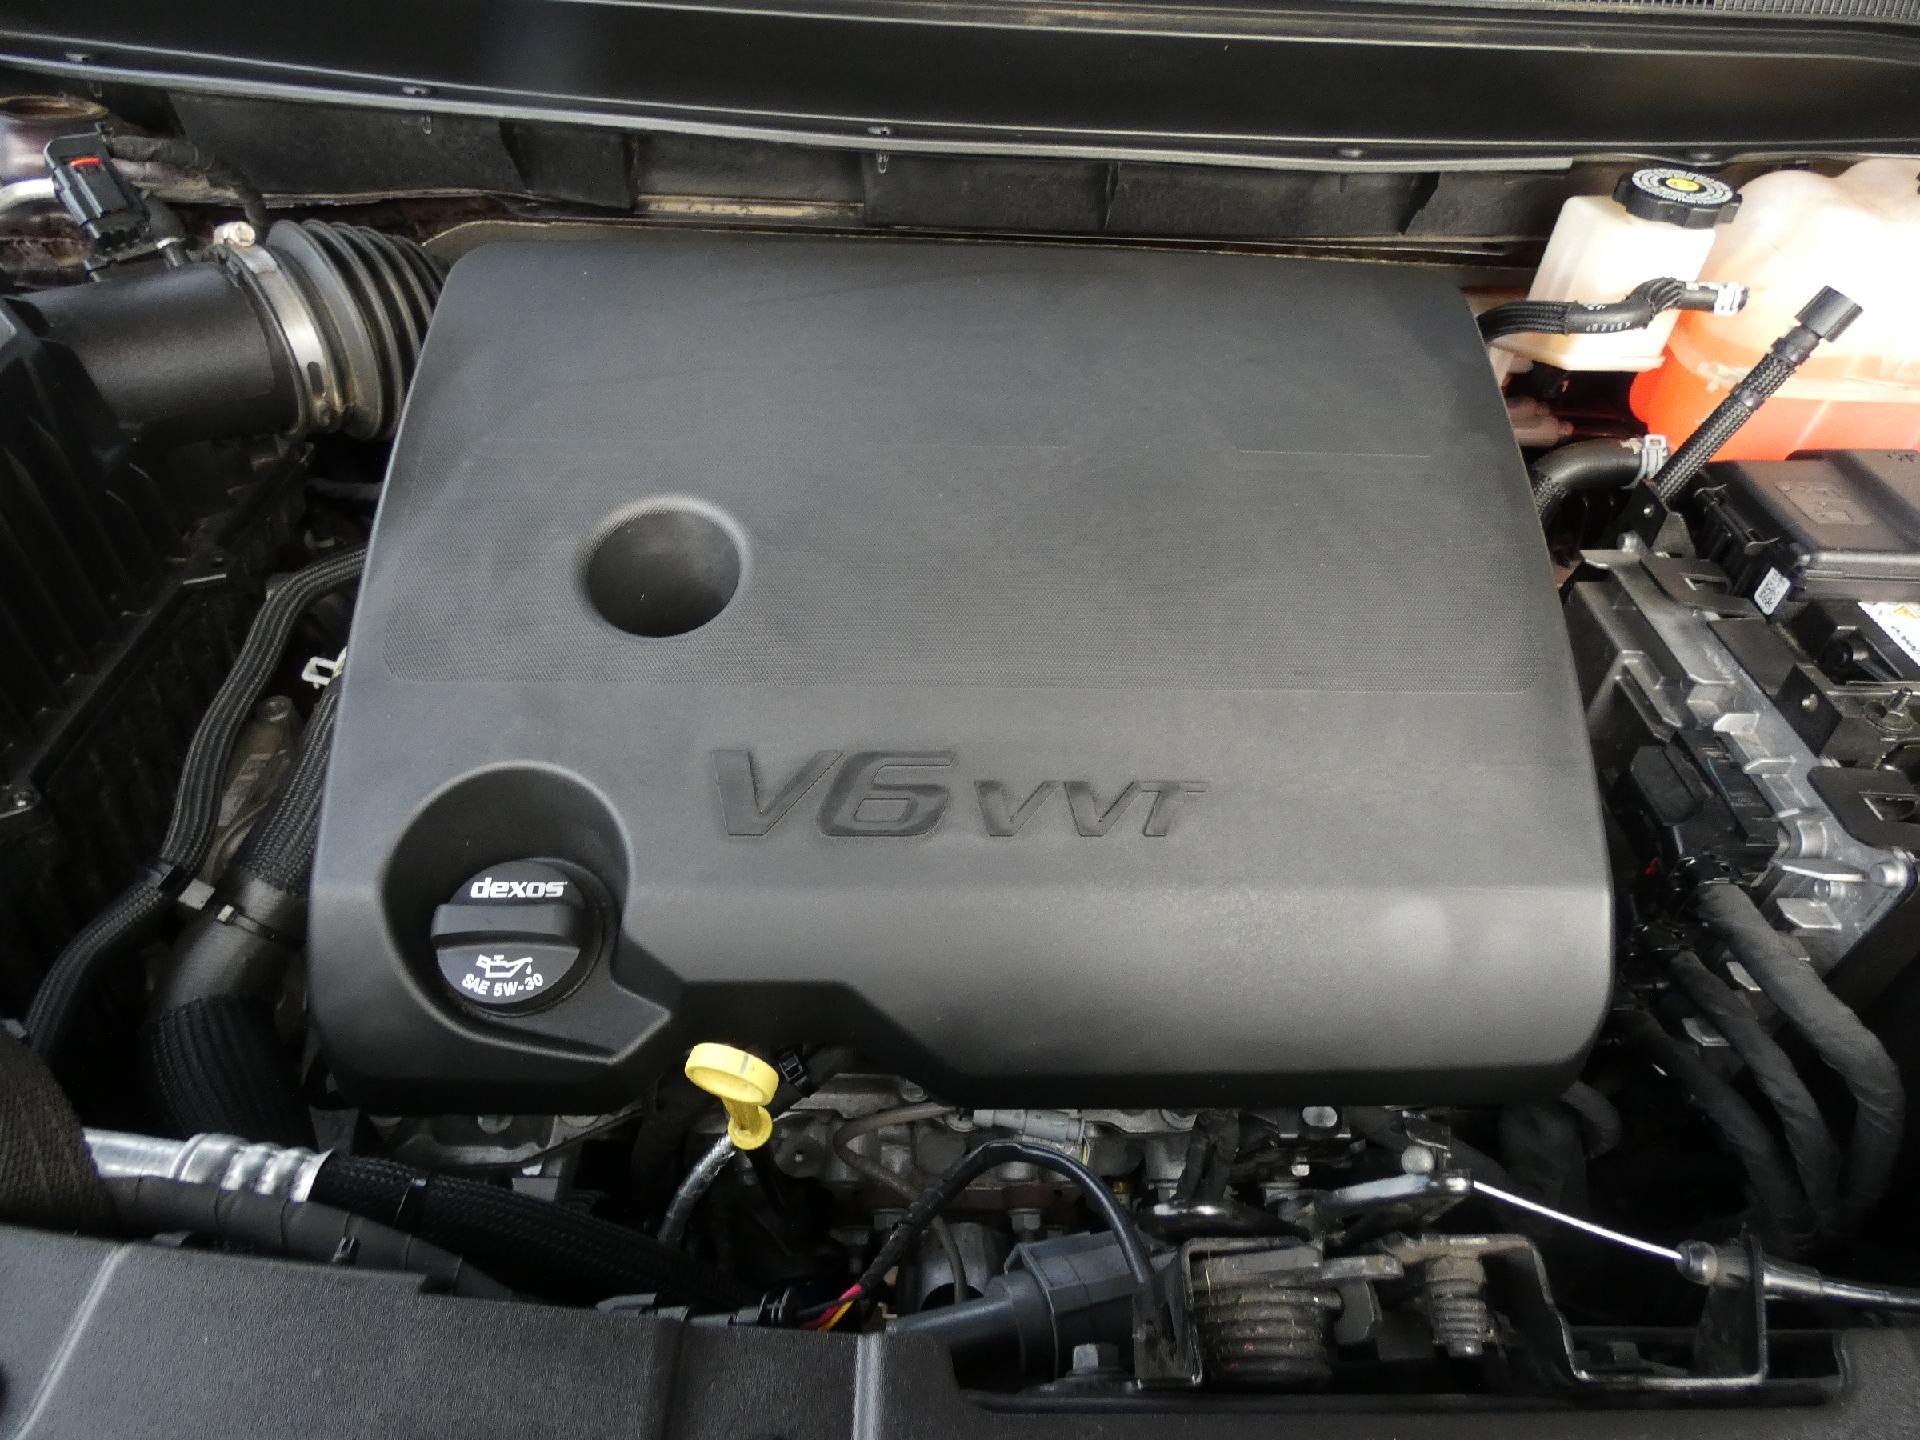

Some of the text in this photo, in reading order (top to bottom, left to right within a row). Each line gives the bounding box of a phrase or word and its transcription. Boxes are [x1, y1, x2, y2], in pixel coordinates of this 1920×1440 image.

[710, 749, 1209, 837] V6 VVT
[470, 877, 566, 899] dexos
[462, 973, 544, 997] SAE 5W-30
